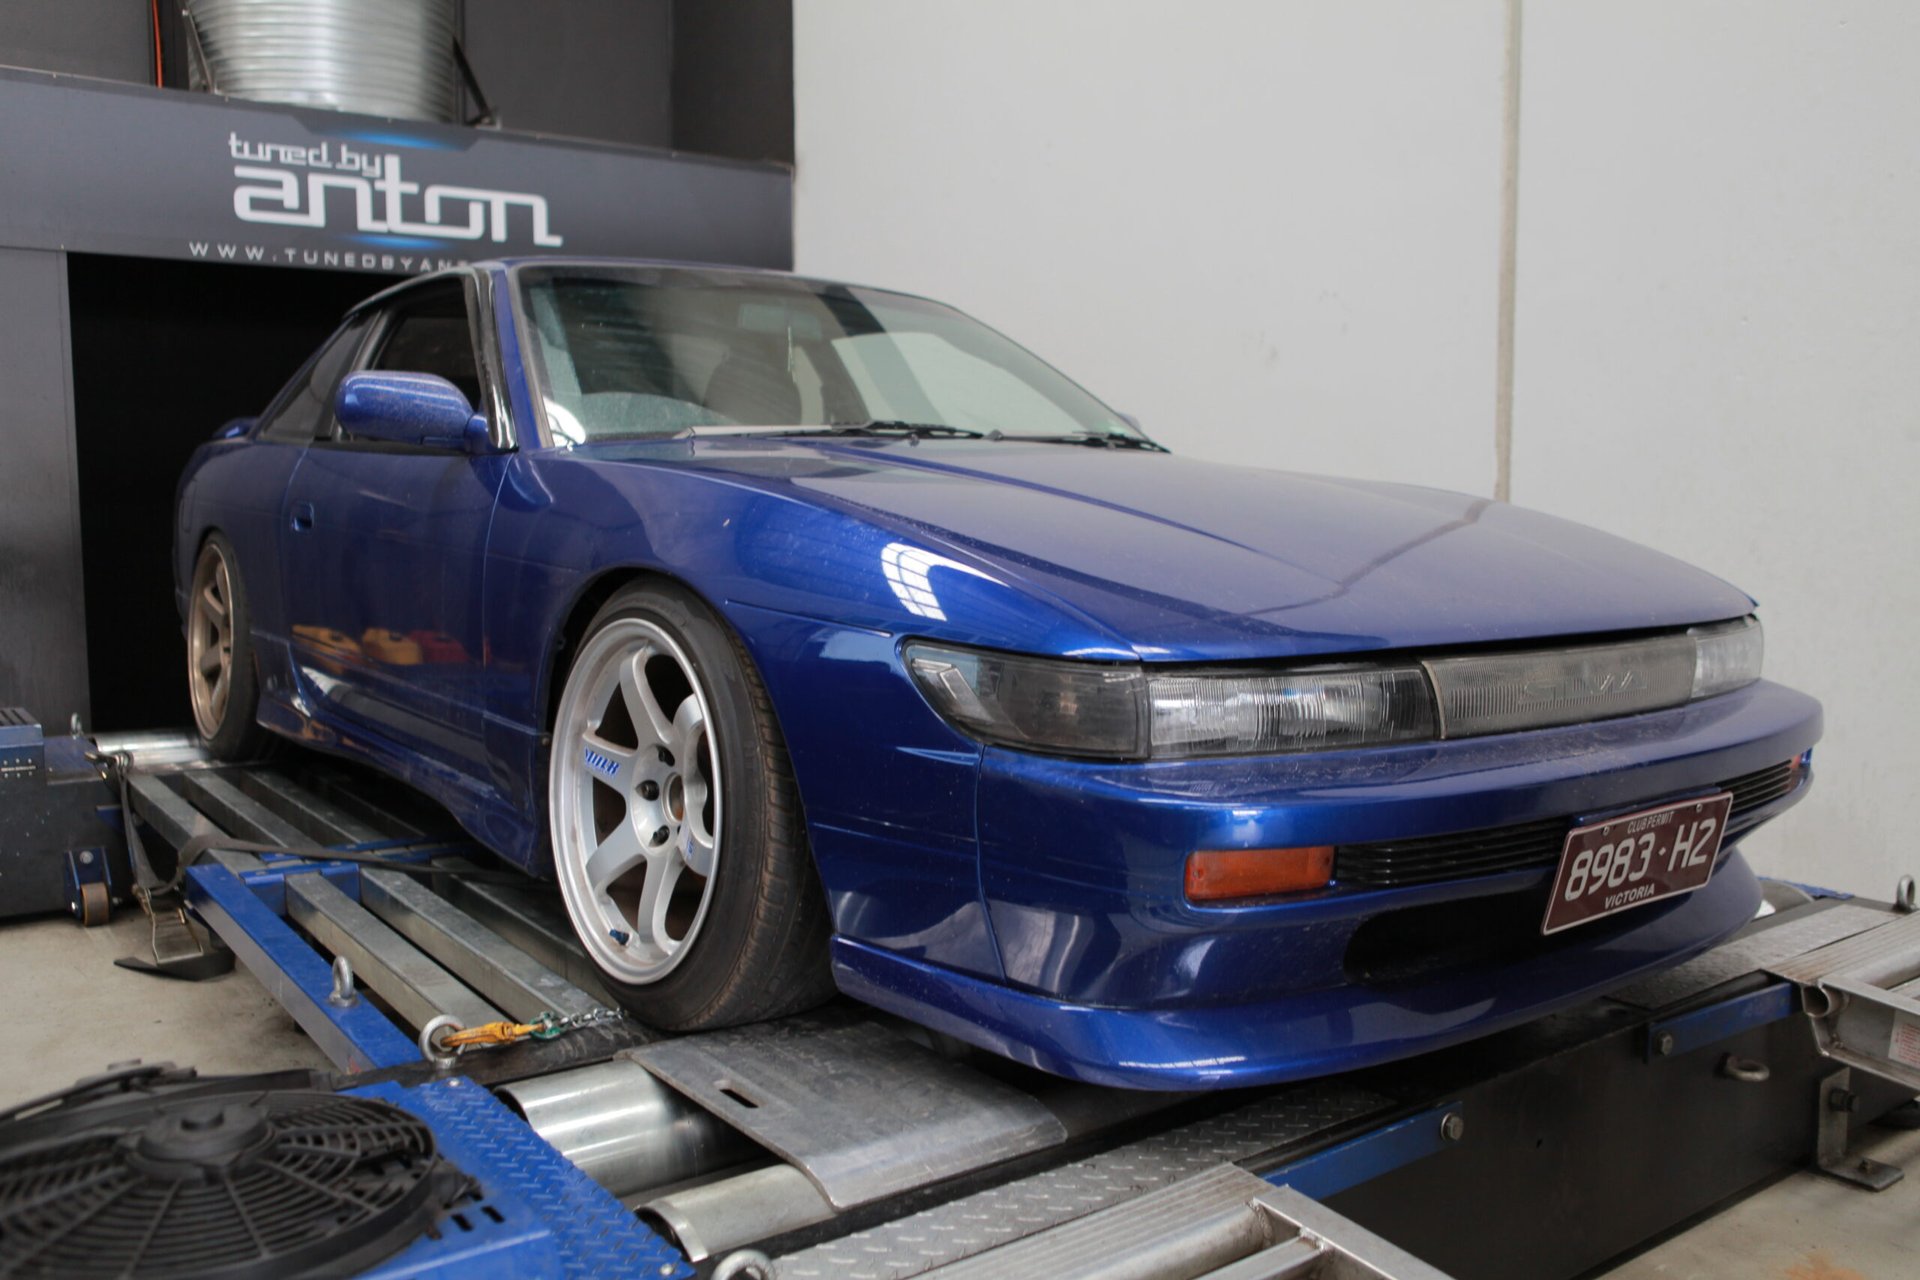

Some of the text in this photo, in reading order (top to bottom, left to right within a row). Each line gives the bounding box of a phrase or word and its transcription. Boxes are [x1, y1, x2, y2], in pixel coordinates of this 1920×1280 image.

[228, 131, 381, 178] tuned by
[233, 153, 563, 247] anton
[1604, 883, 1656, 910] VICTORIA
